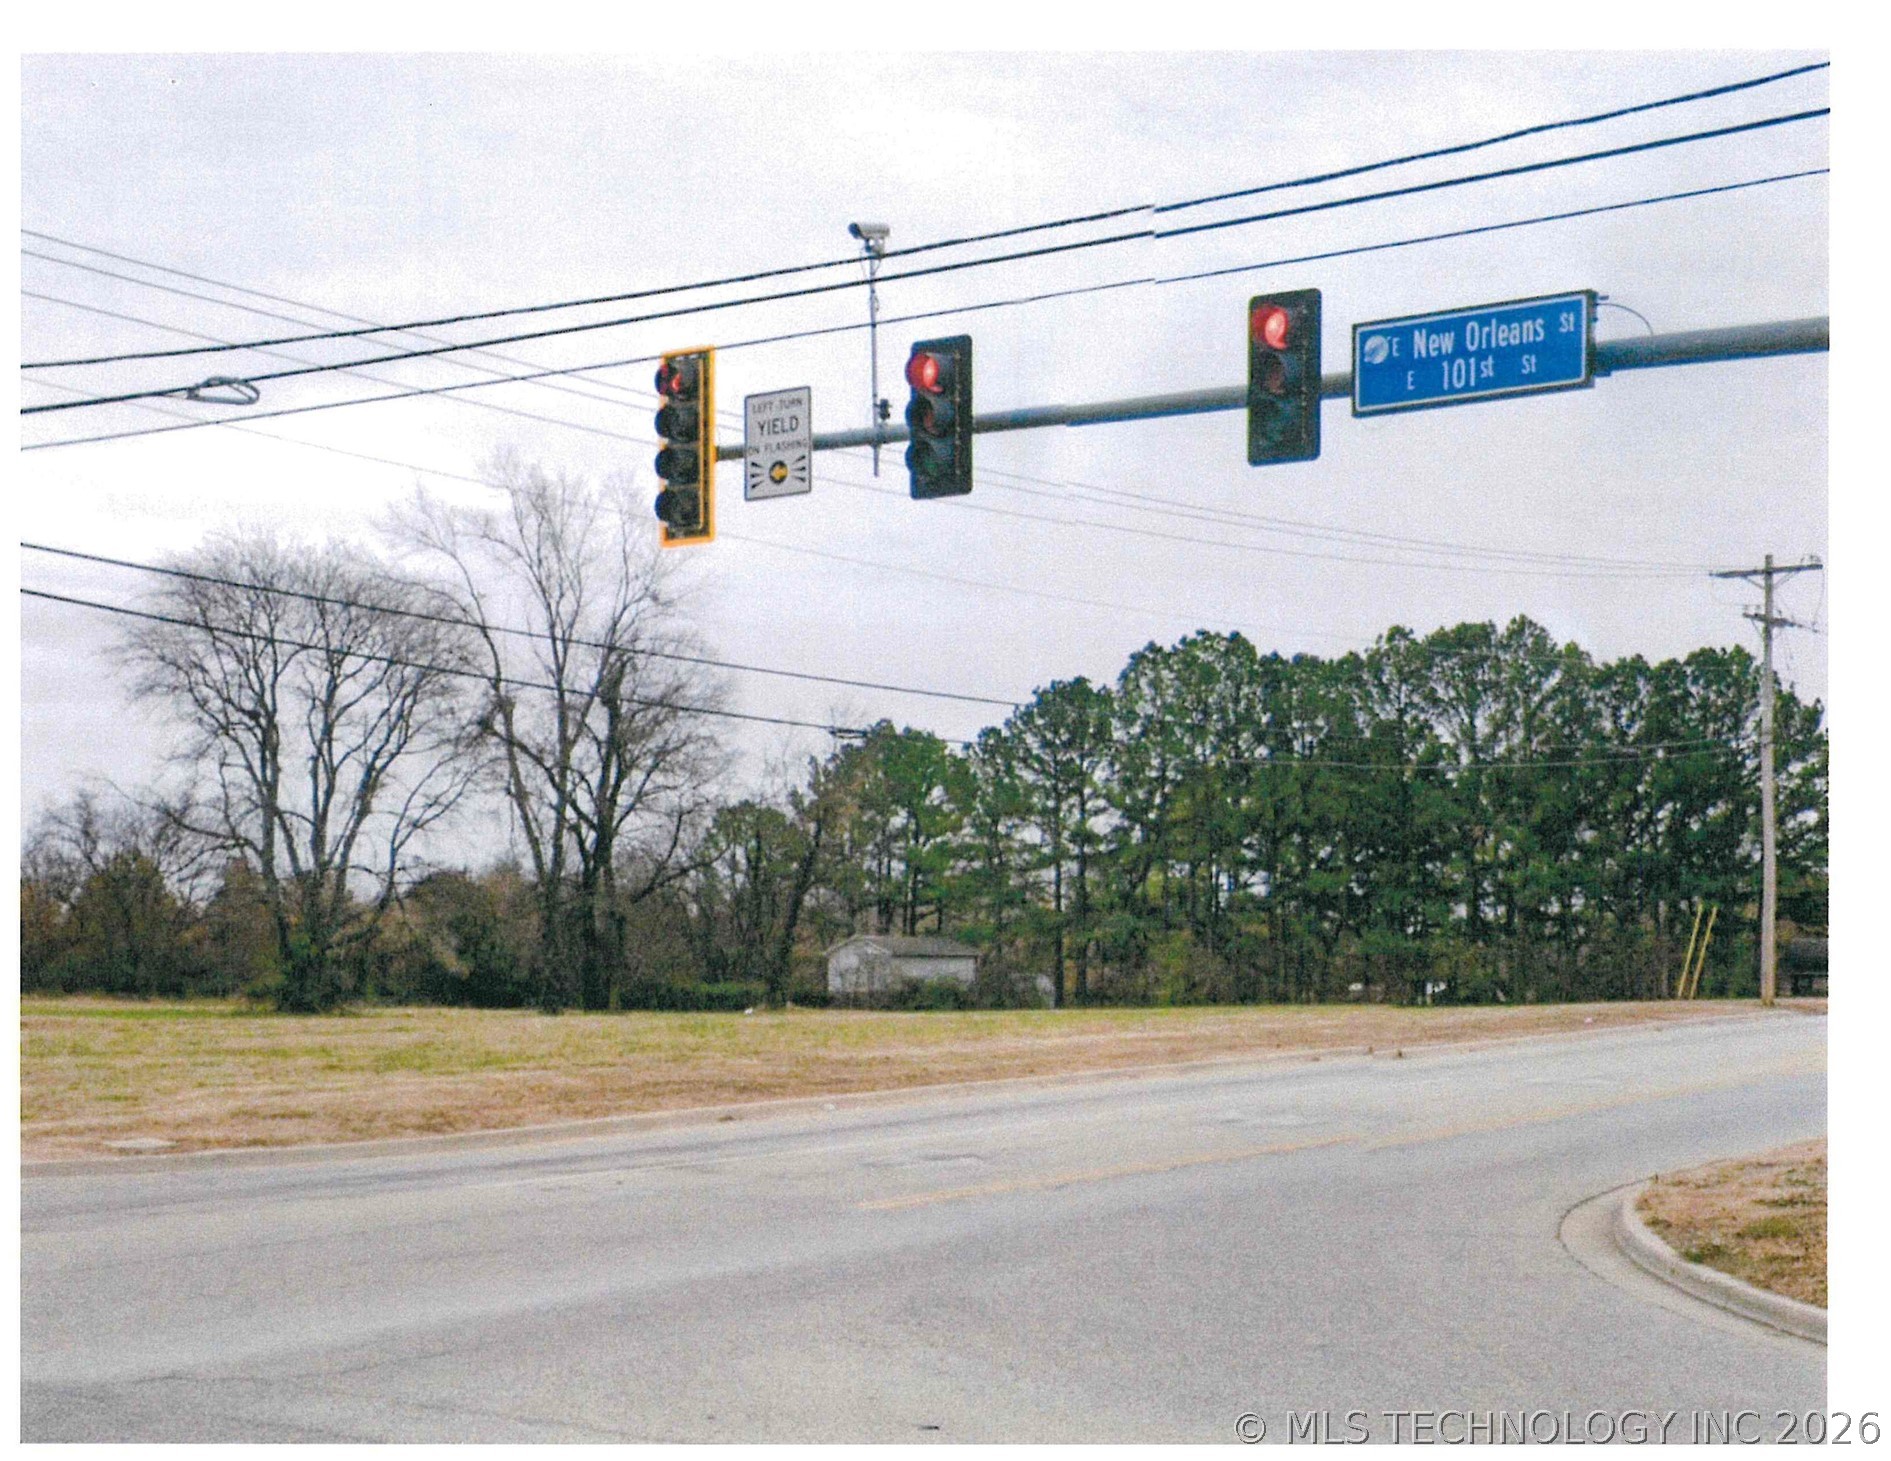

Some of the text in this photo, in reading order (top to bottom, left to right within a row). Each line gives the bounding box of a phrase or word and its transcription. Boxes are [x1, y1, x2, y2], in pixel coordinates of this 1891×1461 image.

[1392, 312, 1575, 359] E New Orleans St
[1407, 354, 1537, 390] E 101st St
[758, 416, 799, 435] YIELD
